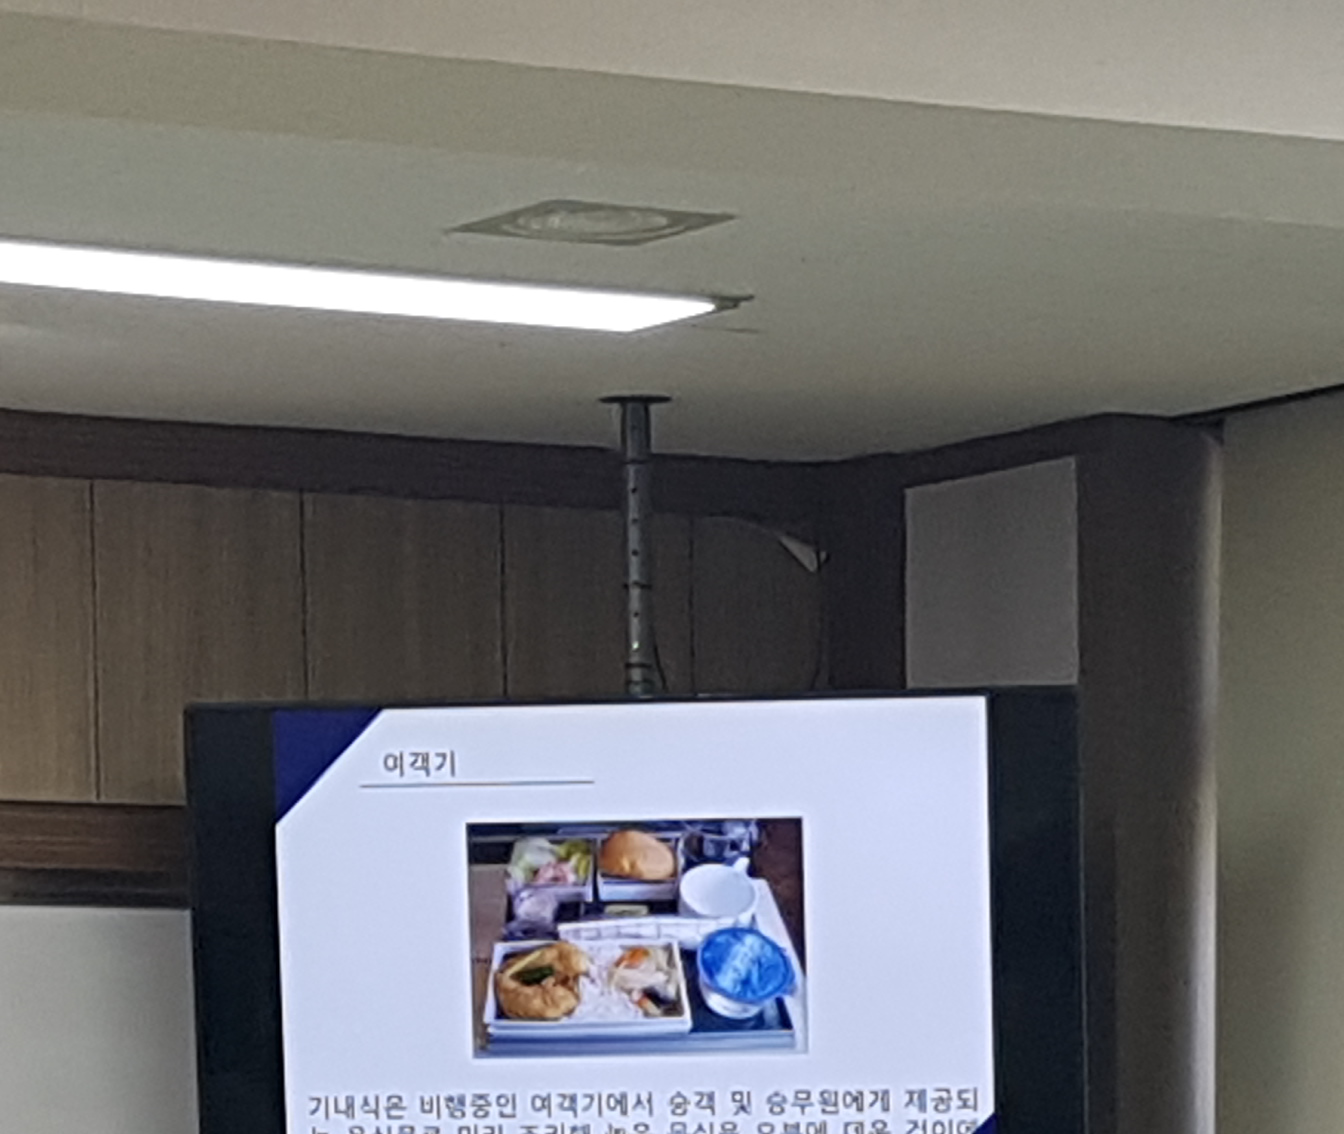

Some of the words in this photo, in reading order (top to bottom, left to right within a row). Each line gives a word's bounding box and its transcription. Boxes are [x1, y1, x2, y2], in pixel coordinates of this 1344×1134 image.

[382, 750, 456, 778] 여객기
[309, 1094, 408, 1121] 기내식은
[419, 1093, 517, 1120] 비행중인
[530, 1091, 654, 1119] 여객기에서
[669, 1090, 716, 1117] 승객
[731, 1090, 752, 1117] 및
[765, 1088, 891, 1116] 승무원에게
[904, 1087, 978, 1114] 제공되
